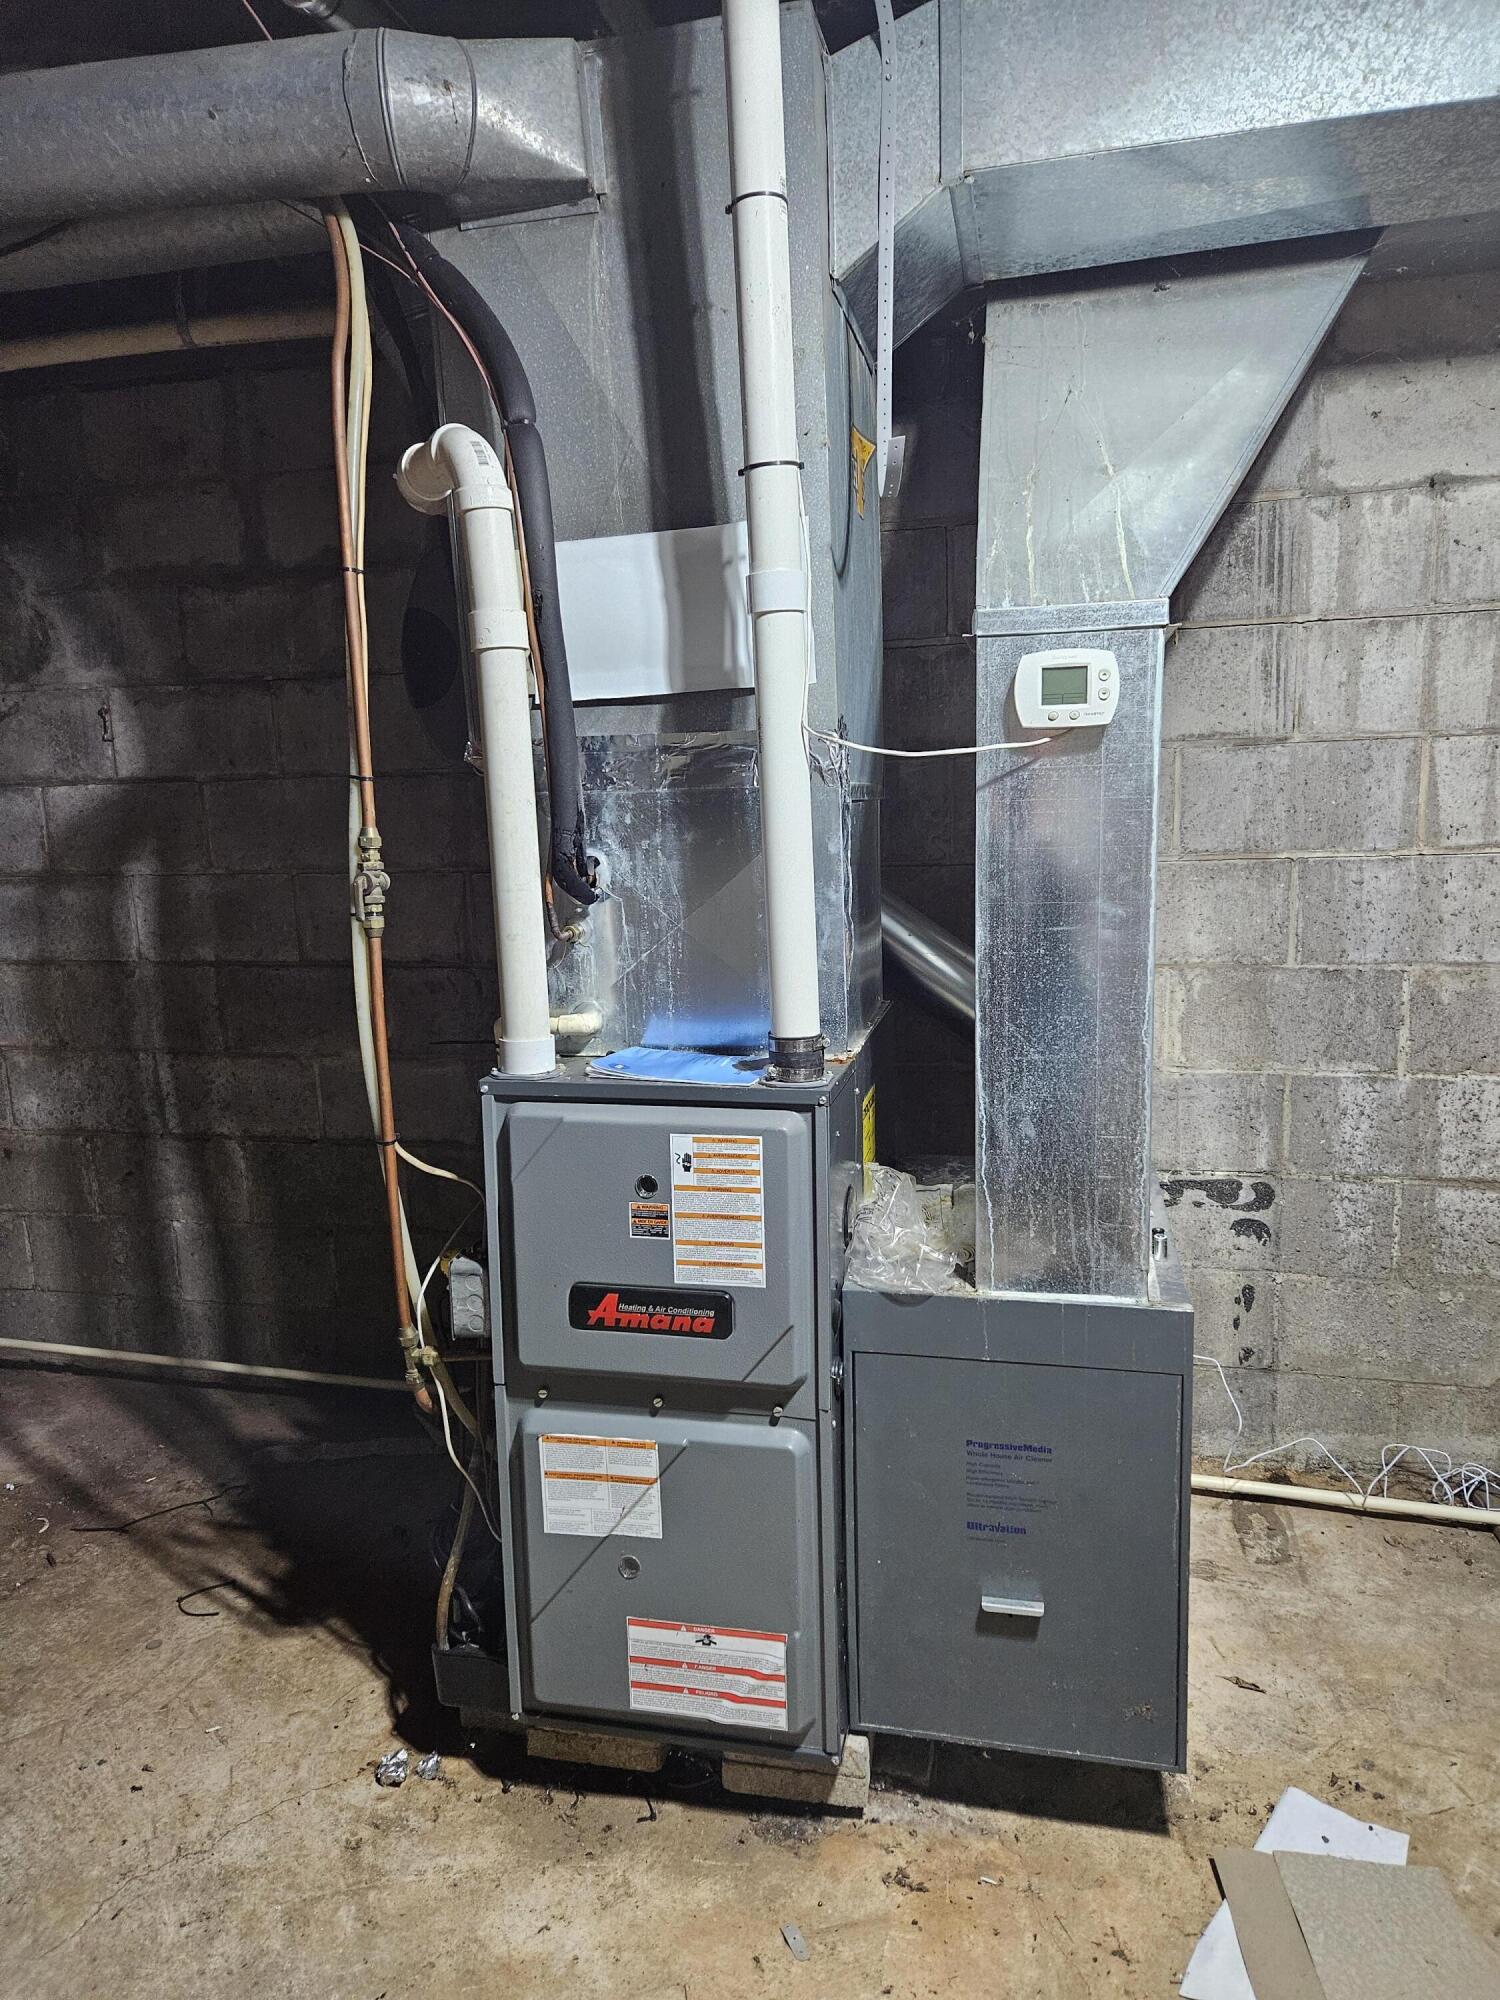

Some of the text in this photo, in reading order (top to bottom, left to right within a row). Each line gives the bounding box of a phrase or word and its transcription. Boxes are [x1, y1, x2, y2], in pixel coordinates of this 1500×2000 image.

[587, 1293, 716, 1333] Amana
[618, 1303, 647, 1313] Heating
[655, 1305, 666, 1313] Air
[667, 1306, 715, 1317] Conditioning
[966, 1440, 1052, 1454] ProgressiveMedia
[967, 1522, 1026, 1534] Ultravation
[693, 1626, 716, 1634] DANGER
